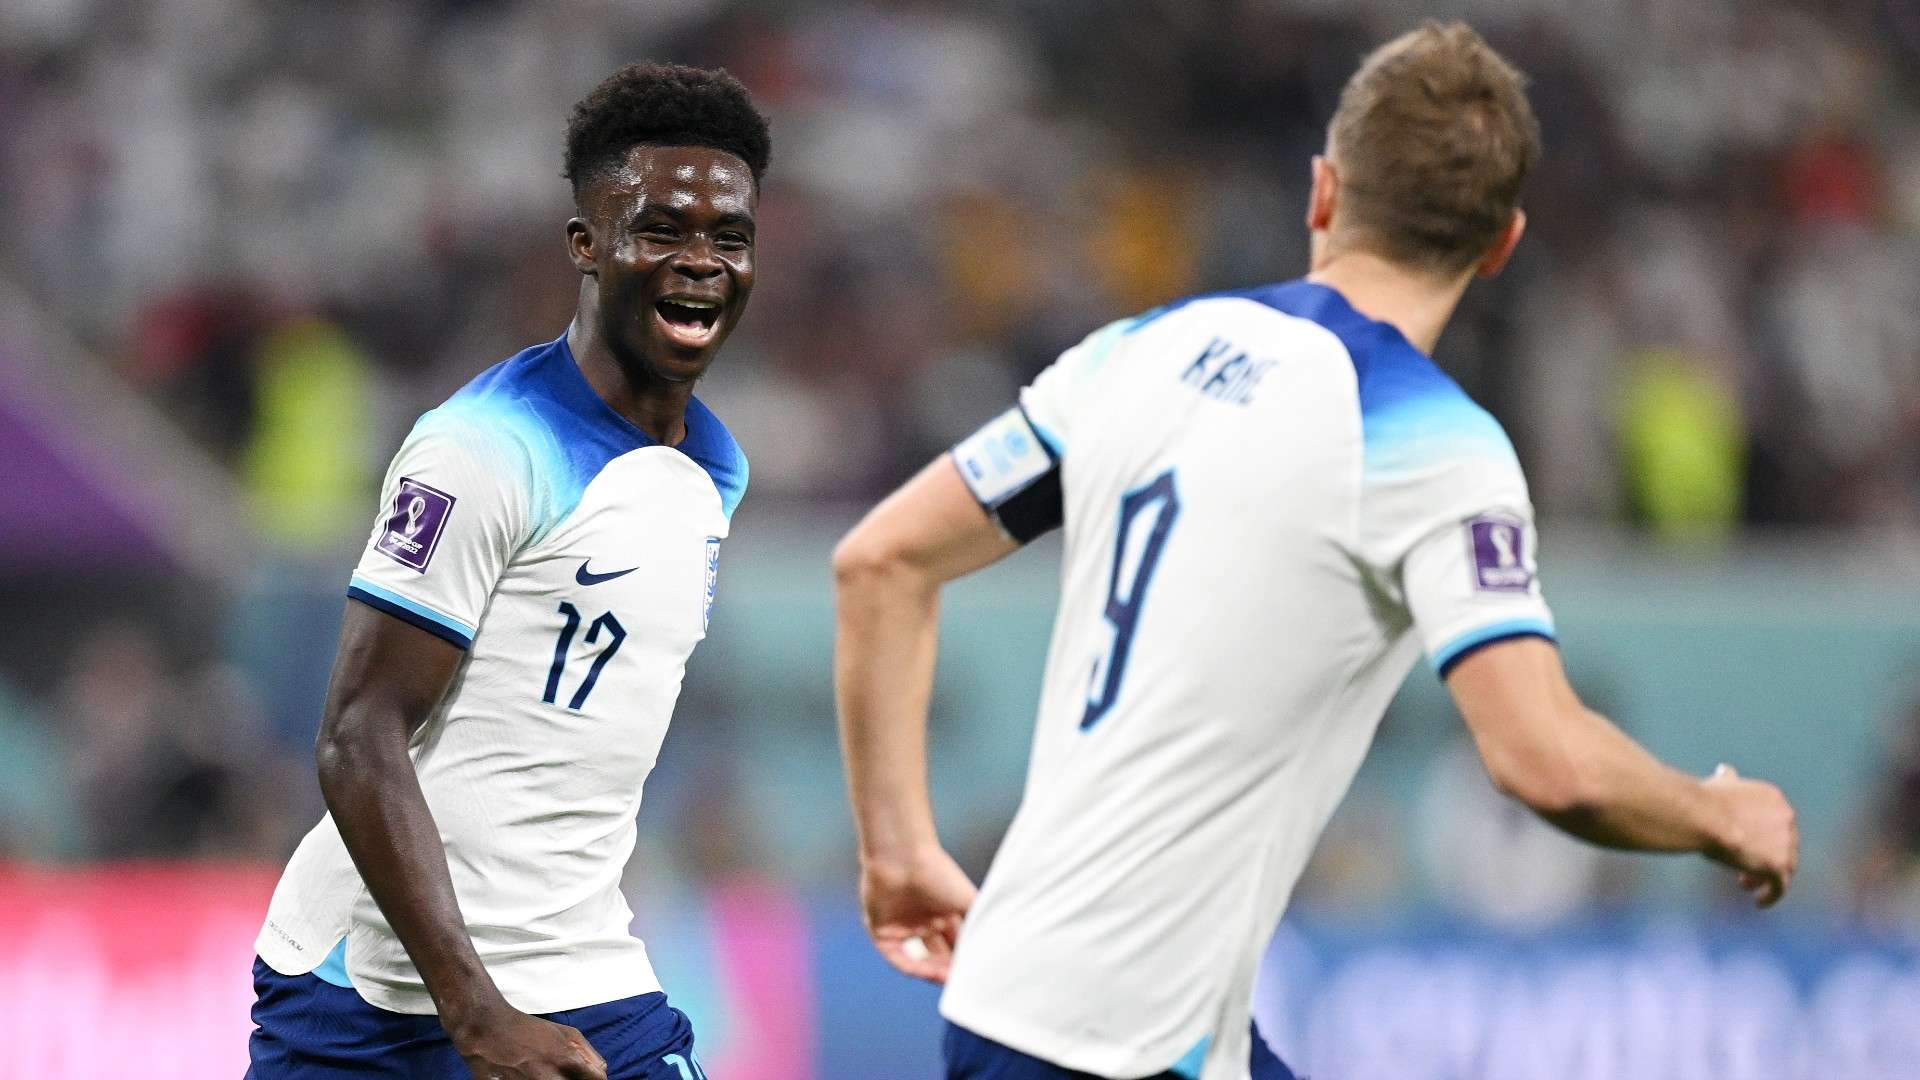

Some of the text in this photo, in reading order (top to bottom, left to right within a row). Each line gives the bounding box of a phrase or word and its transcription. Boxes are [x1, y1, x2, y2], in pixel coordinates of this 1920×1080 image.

[1178, 334, 1279, 406] KANE
[541, 600, 628, 710] 17
[1080, 468, 1180, 732] 9
